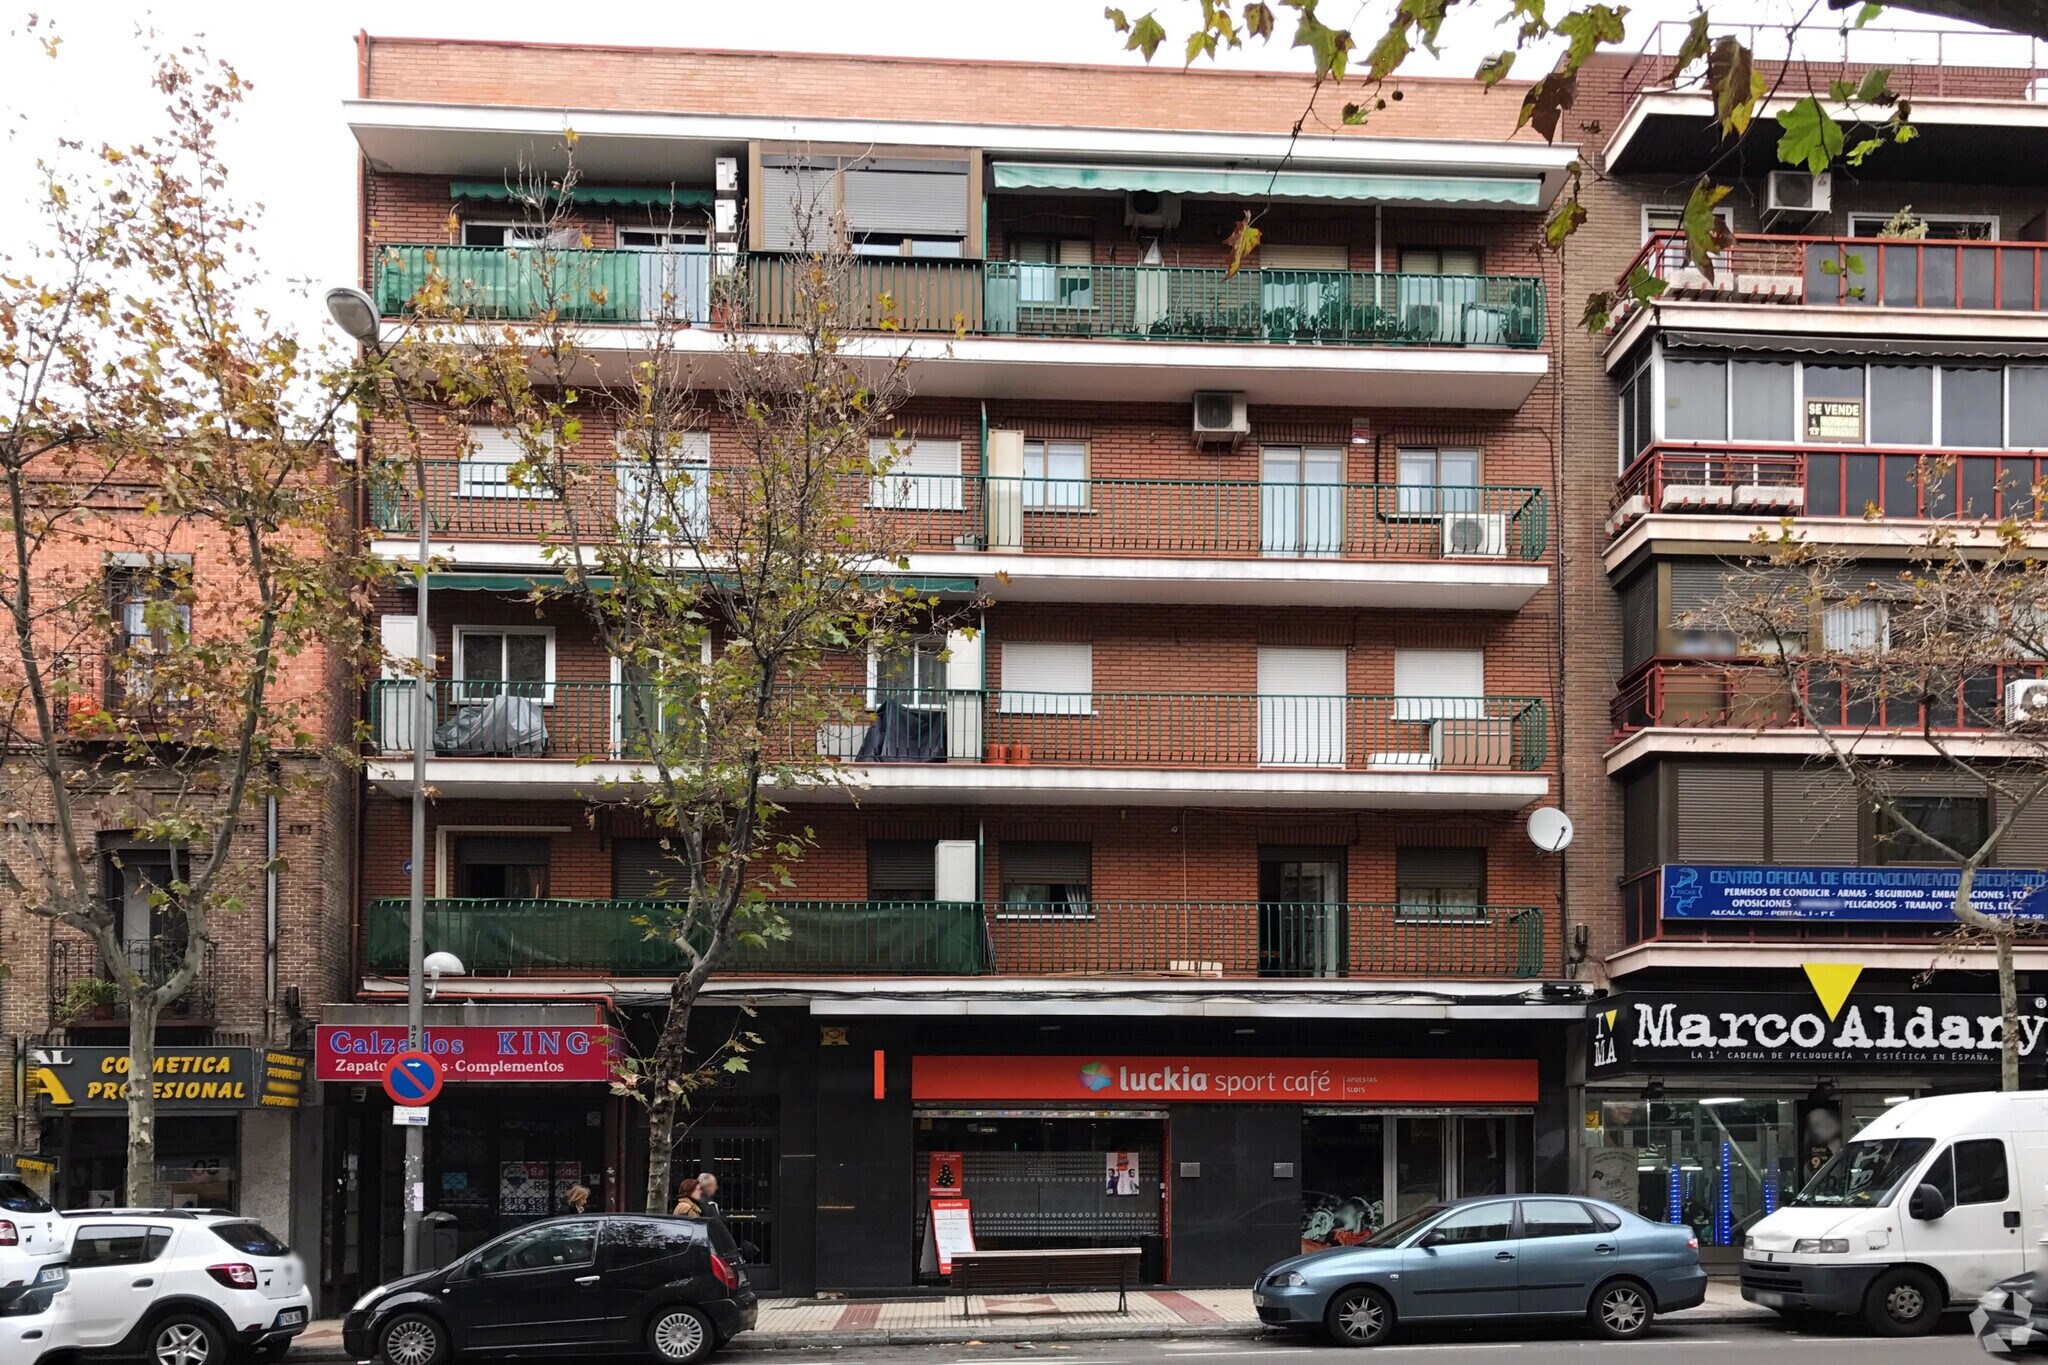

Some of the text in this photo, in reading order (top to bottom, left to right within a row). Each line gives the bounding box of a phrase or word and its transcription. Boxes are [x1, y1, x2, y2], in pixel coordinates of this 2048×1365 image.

[1808, 403, 1859, 416] SE VENDE
[1709, 870, 2046, 887] CENTRO OFICIAL DE RECONOCIMIENTO SICOFÍSICO
[1724, 888, 1768, 897] PERMISOS
[1769, 888, 1781, 897] DE
[1783, 888, 1830, 897] CONDUCIR
[1837, 889, 1867, 898] ARMAS
[1874, 889, 1924, 898] SEGURIDAD
[1731, 899, 1792, 908] OPOSICIONES
[1844, 901, 1897, 910] PELIGROSOS
[1904, 901, 1943, 911] TRABAJO
[1632, 1003, 1825, 1048] Marco
[330, 1031, 464, 1055] Calzaos
[497, 1031, 590, 1055] KING
[1691, 1051, 1702, 1059] LA
[1727, 1052, 1765, 1060] CADENA
[1771, 1052, 1783, 1060] DE
[1790, 1051, 1853, 1060] PELUQUERÍA
[1876, 1051, 1927, 1061] ESTÉTICA
[1933, 1053, 1945, 1061] EN
[101, 1056, 230, 1075] COMETICA
[454, 1059, 564, 1074] Complementos
[1119, 1066, 1331, 1097] luckia sport café
